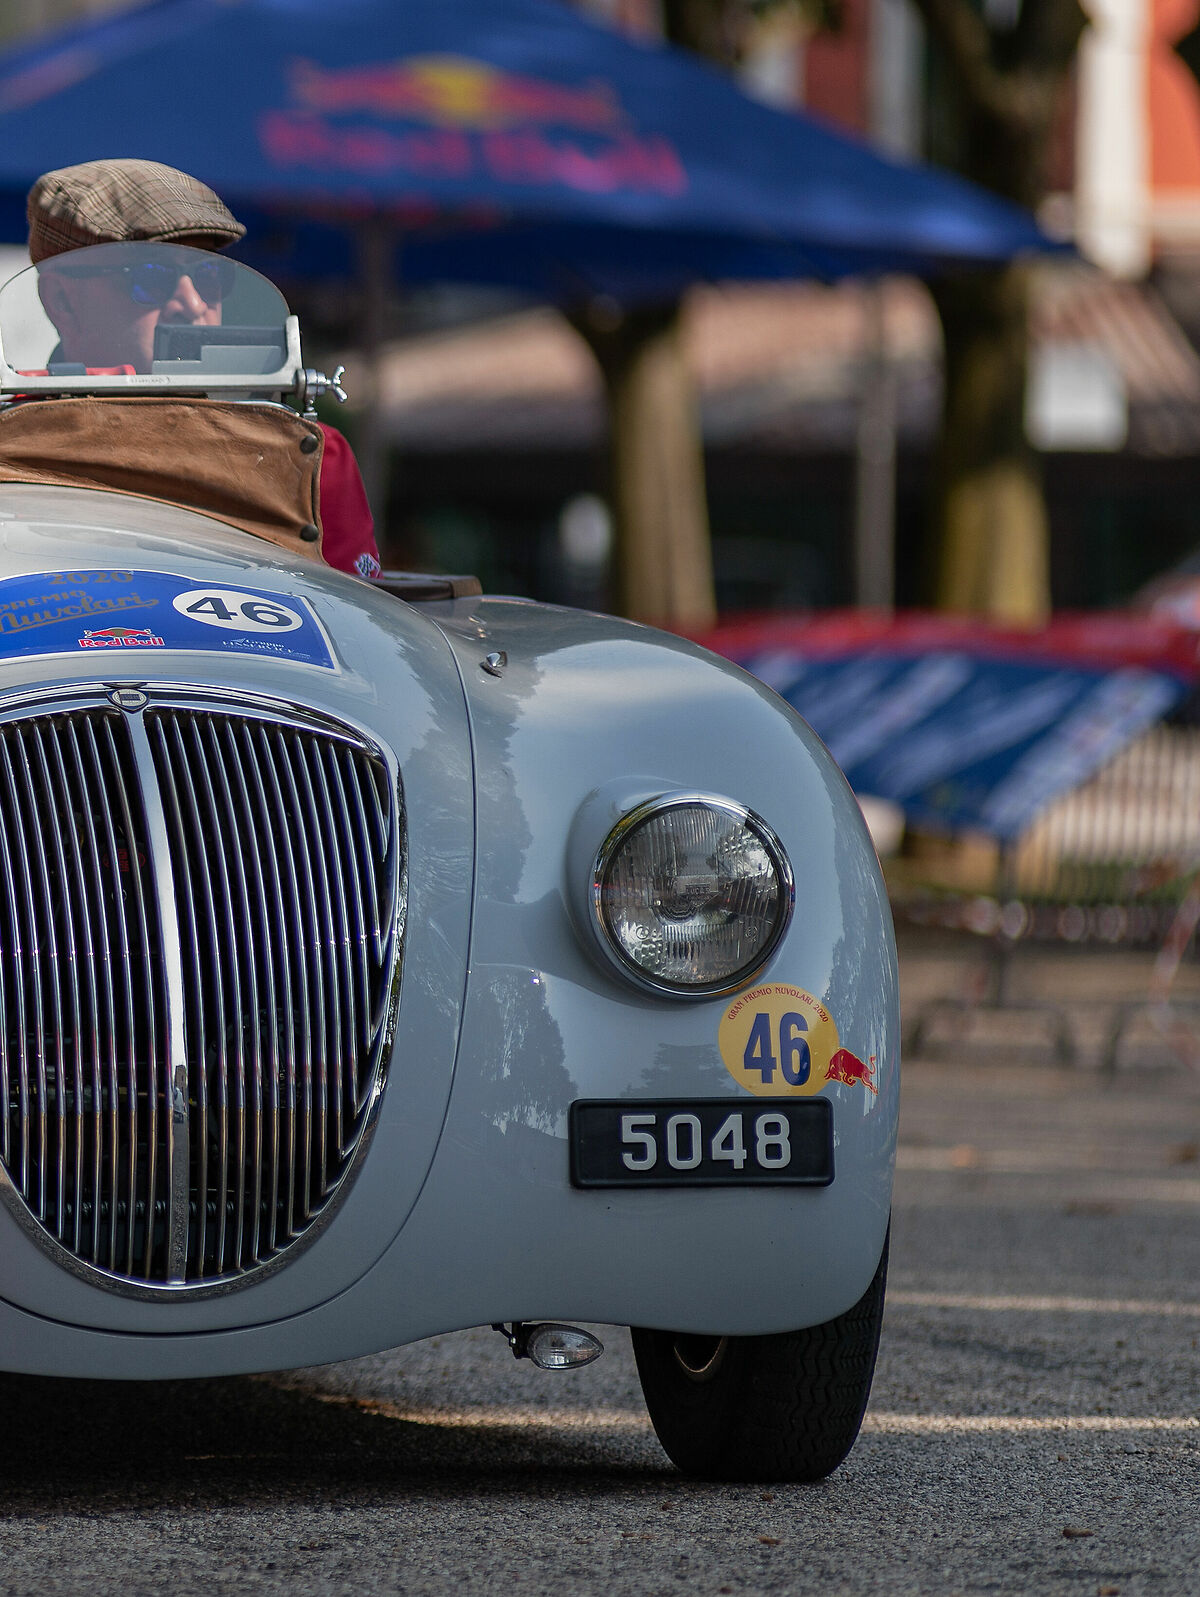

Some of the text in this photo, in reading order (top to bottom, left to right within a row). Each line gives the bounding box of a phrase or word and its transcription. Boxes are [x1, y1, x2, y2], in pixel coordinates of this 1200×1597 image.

[46, 571, 133, 585] 2020
[186, 596, 293, 627] 46
[78, 637, 165, 648] Red Bull
[728, 986, 829, 1023] GRAN PREMIO NUVOLARI 2020
[743, 1012, 812, 1086] 46
[621, 1113, 791, 1171] 5048
